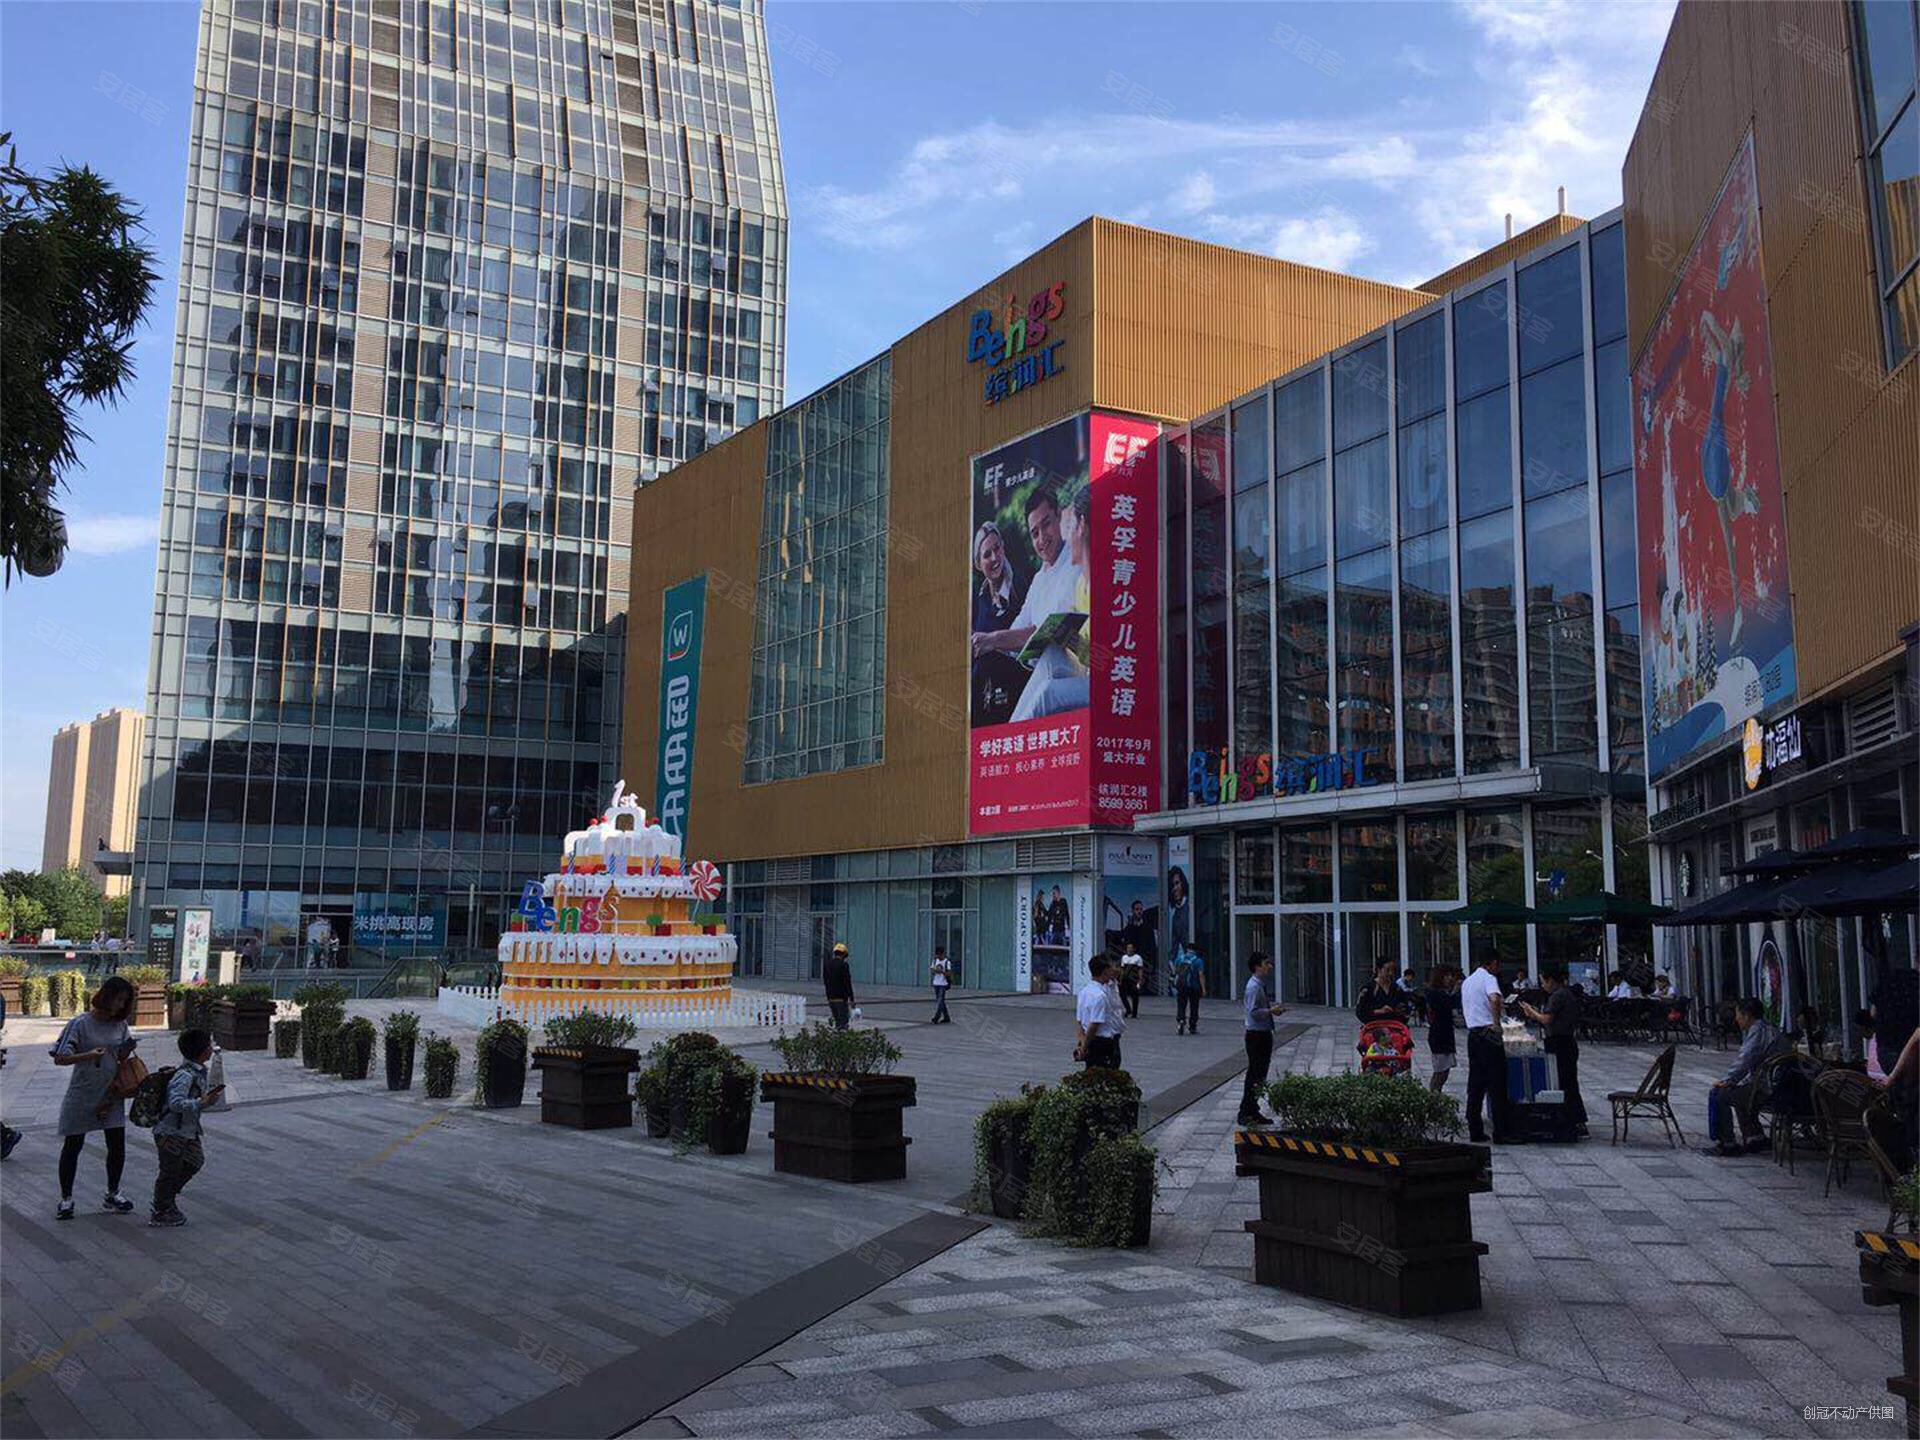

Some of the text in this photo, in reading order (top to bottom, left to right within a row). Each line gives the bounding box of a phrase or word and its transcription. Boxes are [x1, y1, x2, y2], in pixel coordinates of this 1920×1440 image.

[967, 279, 1067, 366] Beings
[984, 339, 1065, 407] 缤润汇
[1103, 432, 1148, 467] EF
[984, 462, 1004, 490] EF
[1110, 493, 1138, 717] 英孚青少儿英语
[979, 725, 1081, 758] 学好英语 世界更大了
[1096, 736, 1152, 751] 2017年9月
[1103, 751, 1146, 765] 盛大开业
[1188, 746, 1273, 807] Beings
[1019, 896, 1029, 975] POLO SPORT
